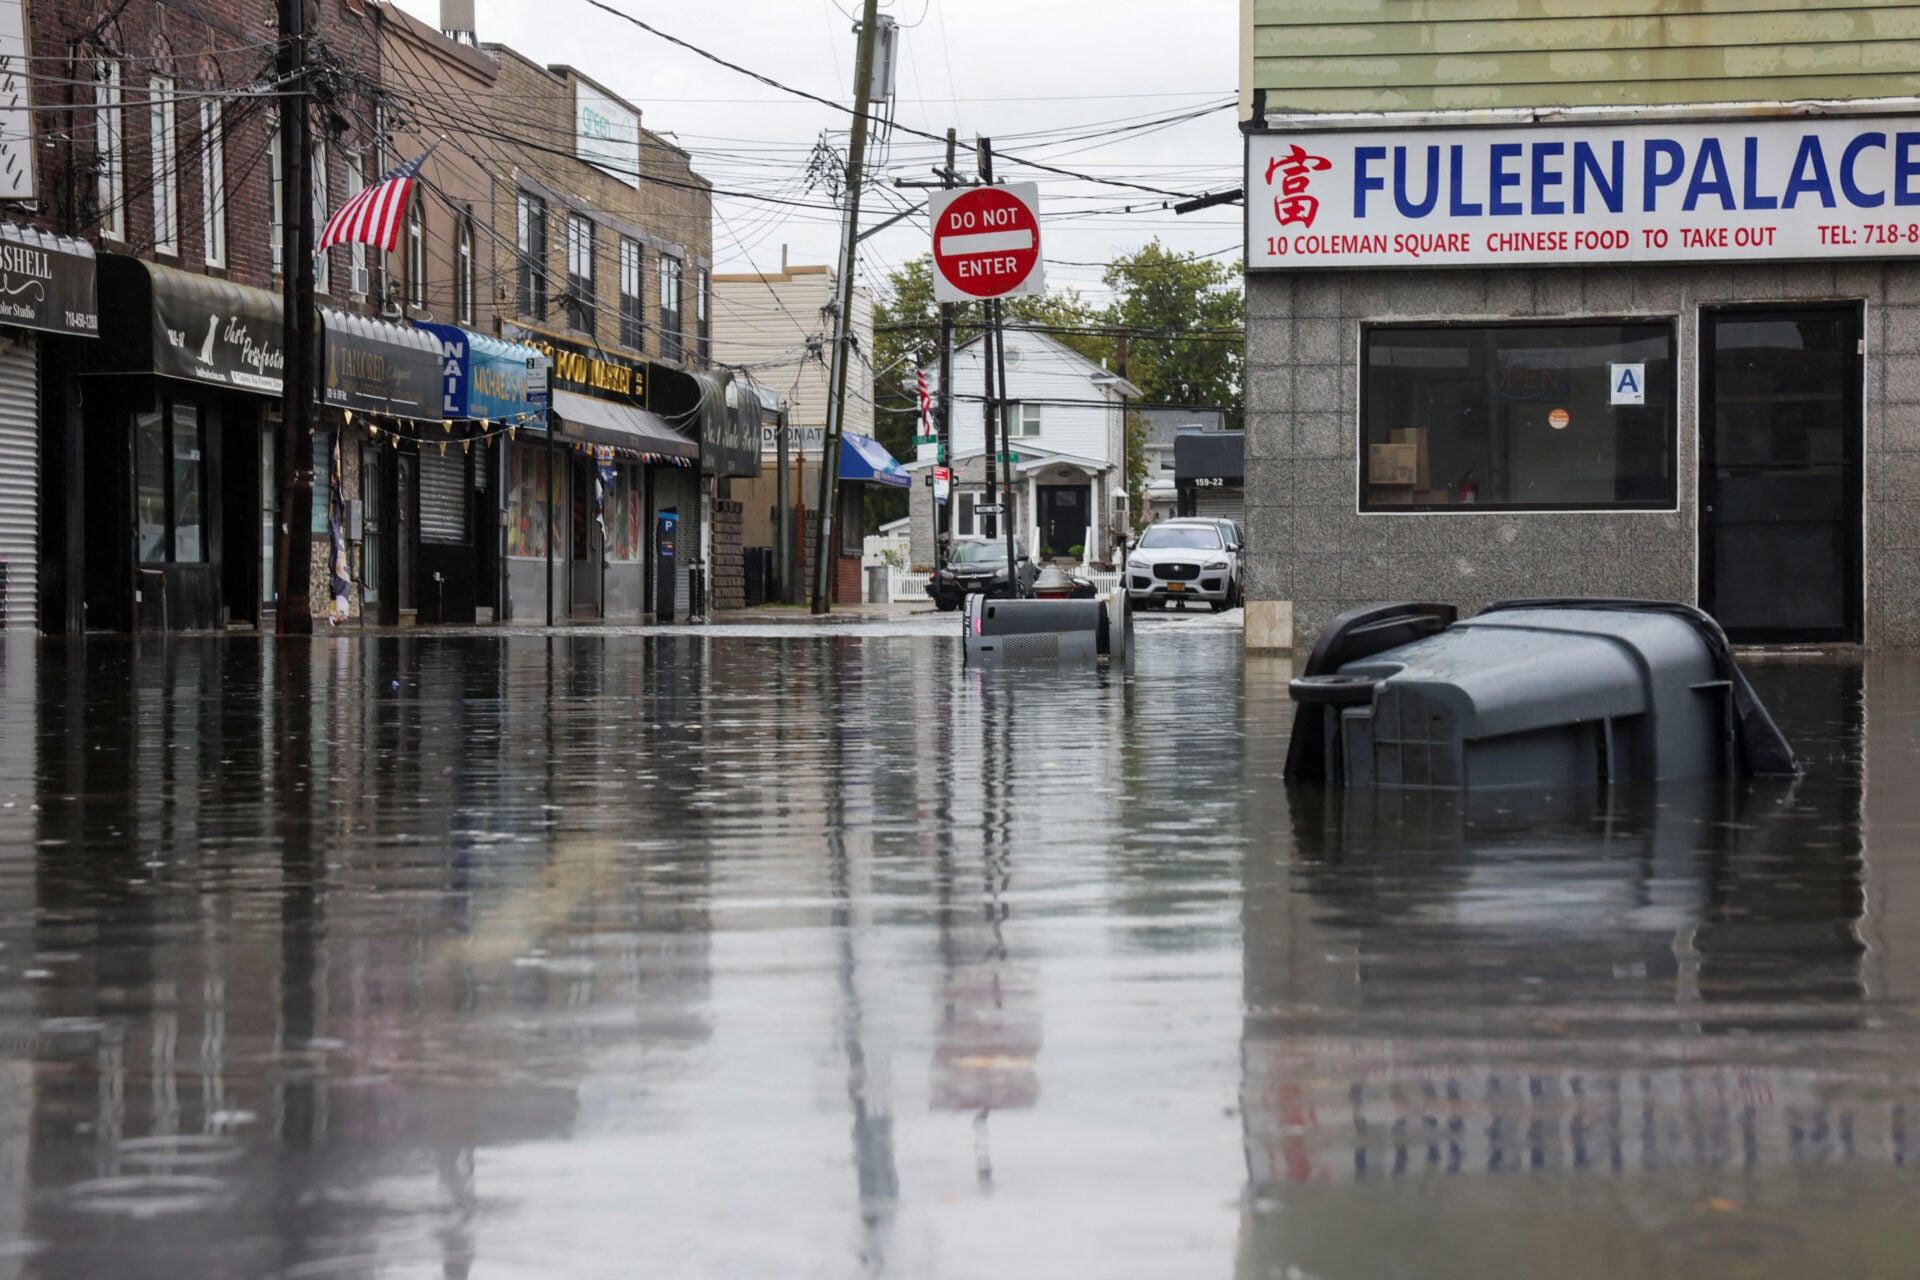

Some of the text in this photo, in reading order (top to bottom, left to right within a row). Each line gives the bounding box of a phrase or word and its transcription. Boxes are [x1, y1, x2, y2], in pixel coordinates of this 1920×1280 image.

[1265, 144, 1332, 228] 富
[1354, 132, 1920, 218] FULEEN PALACE
[950, 207, 1018, 230] DO NOT
[1267, 223, 1920, 257] 10 COLEMAN SQUARE CHINESE FOOD TO TAKE OUT TEL: 718-8
[958, 256, 1018, 278] ENTER
[0, 300, 35, 320] olor Studio
[443, 341, 463, 412] NAIL
[556, 348, 587, 384] FOOD
[588, 356, 632, 395] MARKET
[1488, 366, 1560, 390] OPEN
[1616, 369, 1639, 393] A
[1195, 477, 1224, 487] 159-22
